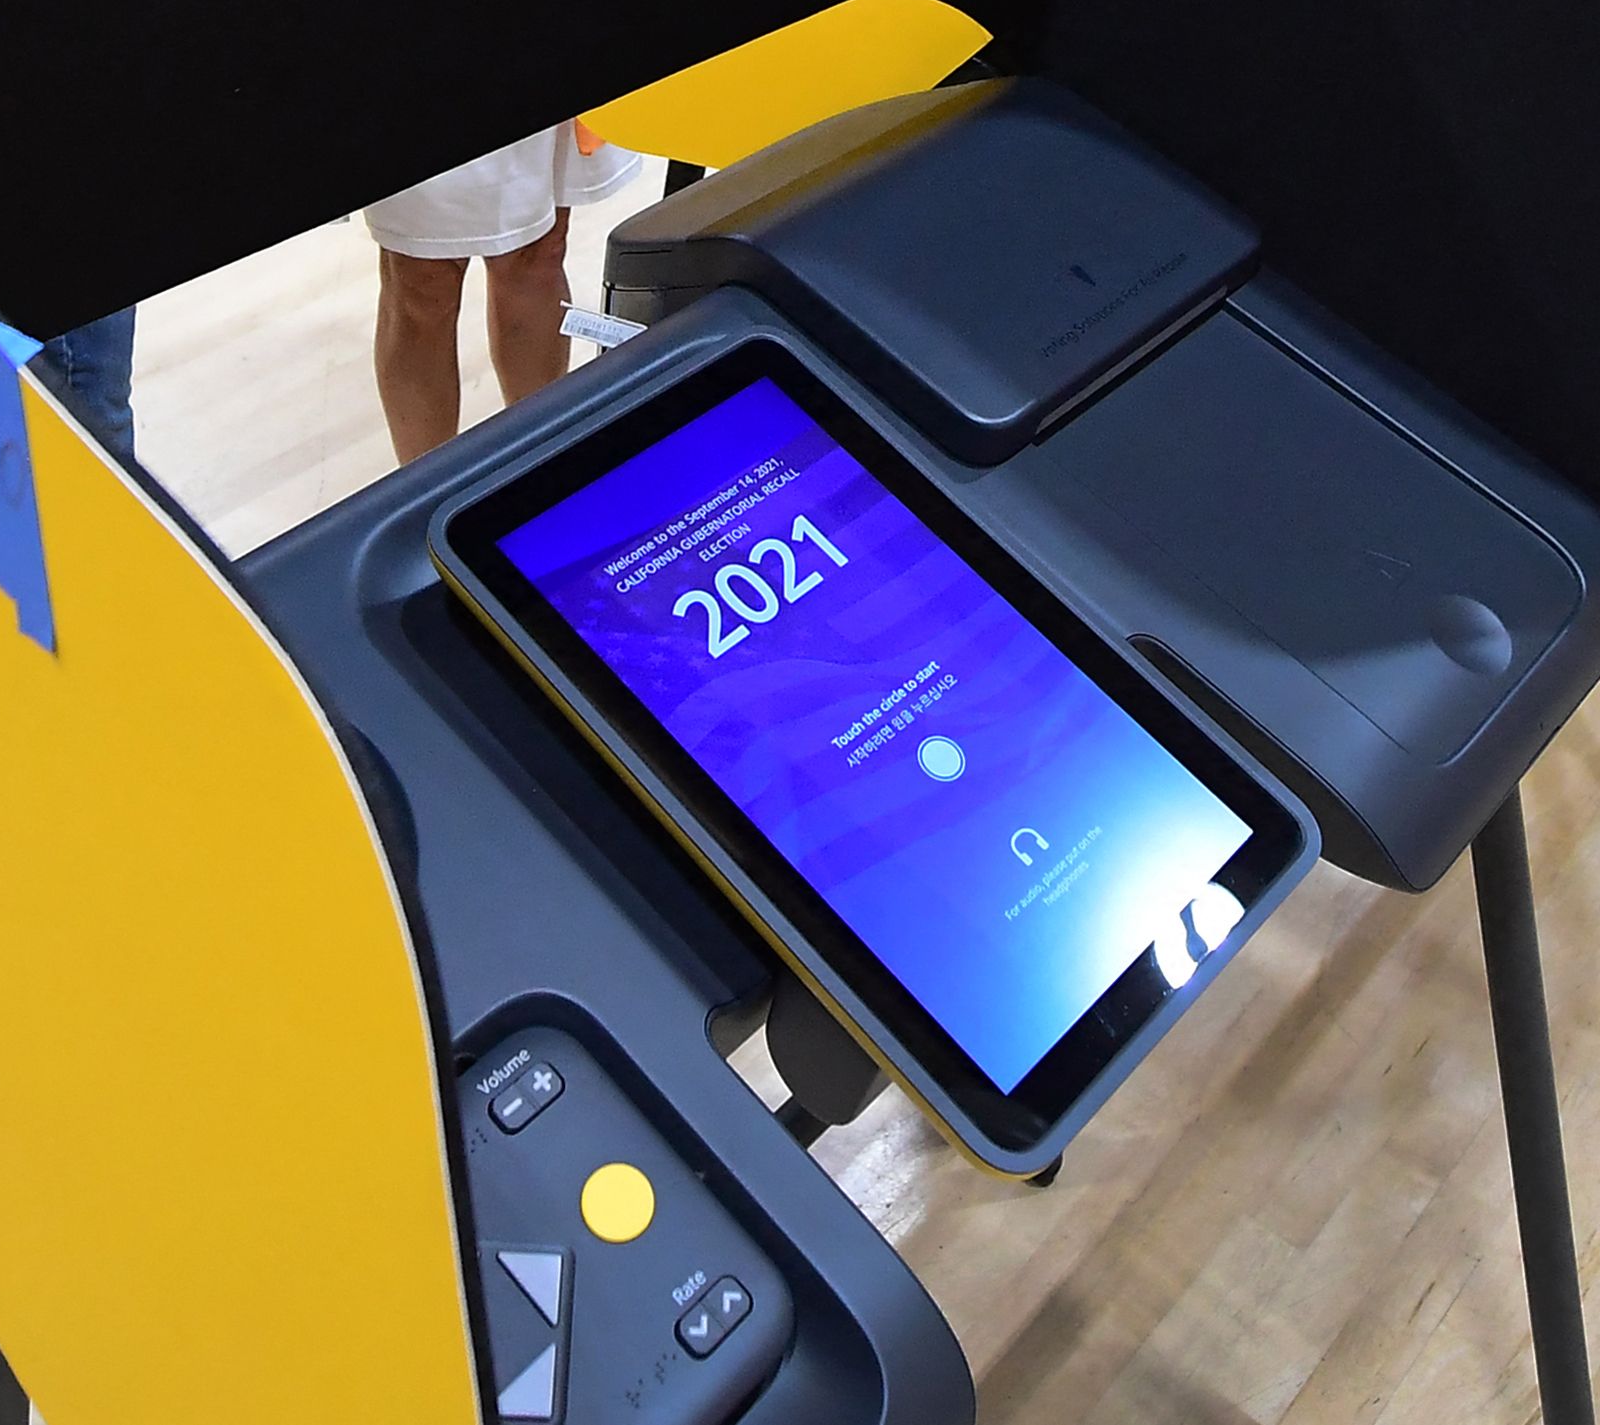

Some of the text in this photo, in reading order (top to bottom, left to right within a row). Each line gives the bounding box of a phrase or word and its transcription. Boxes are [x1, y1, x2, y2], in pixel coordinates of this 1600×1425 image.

[603, 456, 784, 577] Welcome to the September 14, 2021,
[615, 467, 801, 593] CALIFORNIA GUBERNATORIAL RECALL
[698, 522, 752, 563] ELECTION
[672, 514, 849, 659] 2021
[831, 660, 941, 749] Touch the circle to start
[846, 674, 958, 768] 시작하려면 원을 누르십시오
[1042, 860, 1068, 889] please
[1065, 846, 1079, 865] put
[1078, 837, 1090, 851] on
[1087, 826, 1103, 841] the
[476, 1049, 531, 1094] Volume
[671, 1270, 707, 1306] Rate
